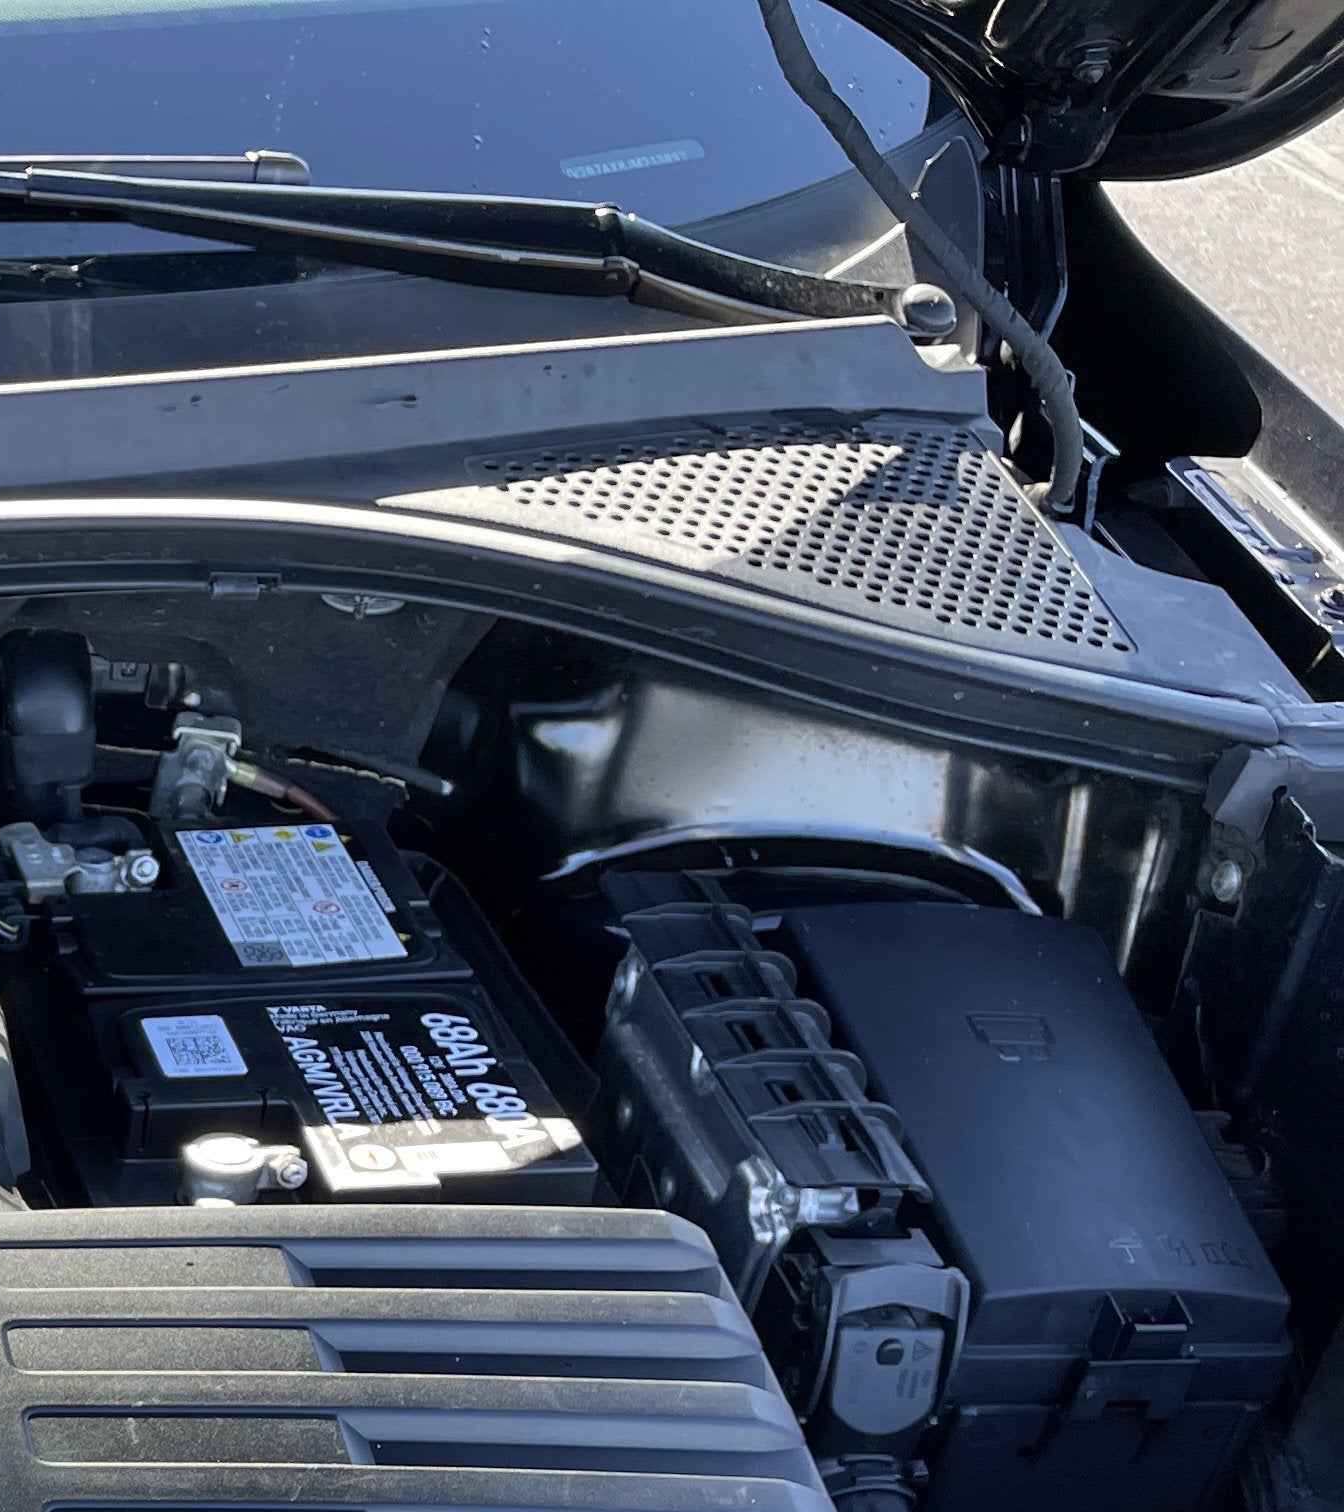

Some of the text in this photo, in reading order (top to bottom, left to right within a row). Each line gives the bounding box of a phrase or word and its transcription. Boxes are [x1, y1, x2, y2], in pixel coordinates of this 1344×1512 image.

[283, 1037, 371, 1139] AGM/VRLA
[420, 1012, 548, 1149] 68Ah 680A
